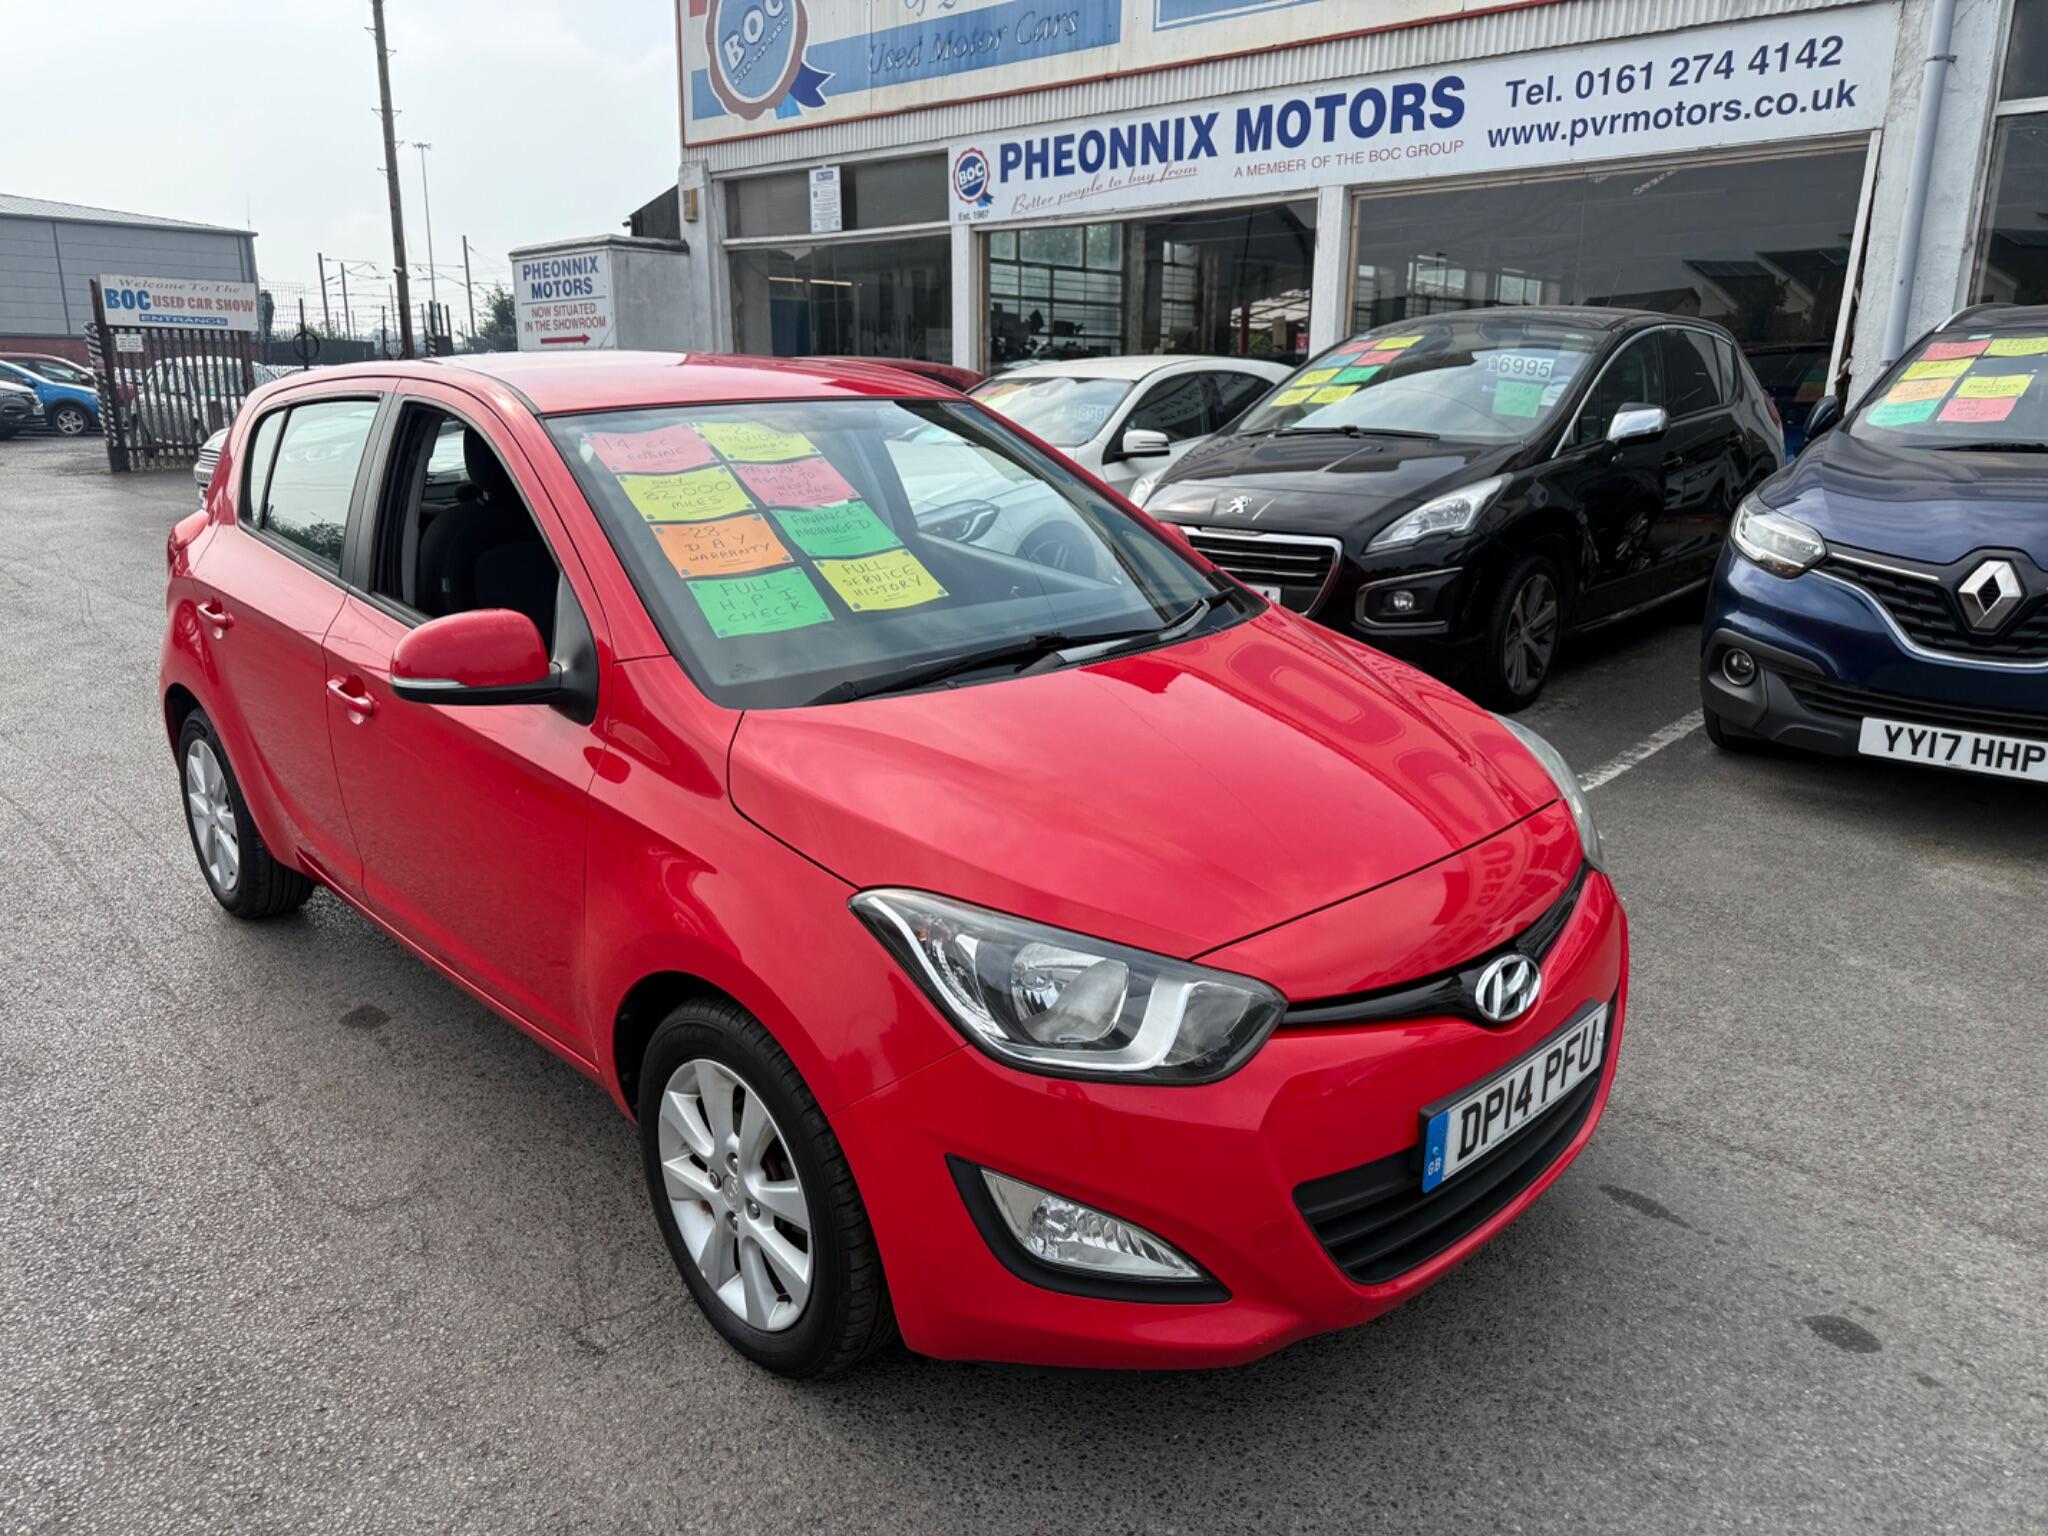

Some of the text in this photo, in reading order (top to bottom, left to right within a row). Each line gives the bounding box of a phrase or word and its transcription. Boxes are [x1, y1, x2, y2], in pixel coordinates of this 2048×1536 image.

[868, 10, 1079, 74] Used Motor Cars
[1505, 35, 1844, 108] Tel. 0161 274 4142
[1487, 79, 1858, 148] www.pvrmotors.co.uk
[1000, 75, 1465, 183] PHEONNIX MOTORS
[1234, 139, 1464, 178] A MEMBER OF THE BOC GROUP
[958, 164, 984, 186] BOC
[1011, 160, 1198, 215] Better people to buy from
[522, 256, 599, 280] PHEONNIX
[118, 279, 240, 293] Welcome To The
[531, 277, 593, 299] MOTORS
[104, 288, 253, 312] BOC USED CAR SHOW
[531, 302, 596, 318] NOW SITUATED
[140, 314, 227, 325] ENTRANCE
[525, 316, 606, 332] IN THE SHOWROOM
[791, 507, 860, 525] FINANCE
[795, 519, 871, 537] ARRANGED
[841, 560, 888, 575] FULL
[842, 564, 915, 586] SERVICE
[719, 579, 781, 597] FULL
[853, 575, 922, 597] HISTORY
[728, 600, 808, 623] CHECK
[1885, 725, 2046, 772] YY17 HHP
[1457, 1066, 1534, 1162] DP14
[1541, 1018, 1599, 1103] PFU
[1427, 1157, 1442, 1177] GB
